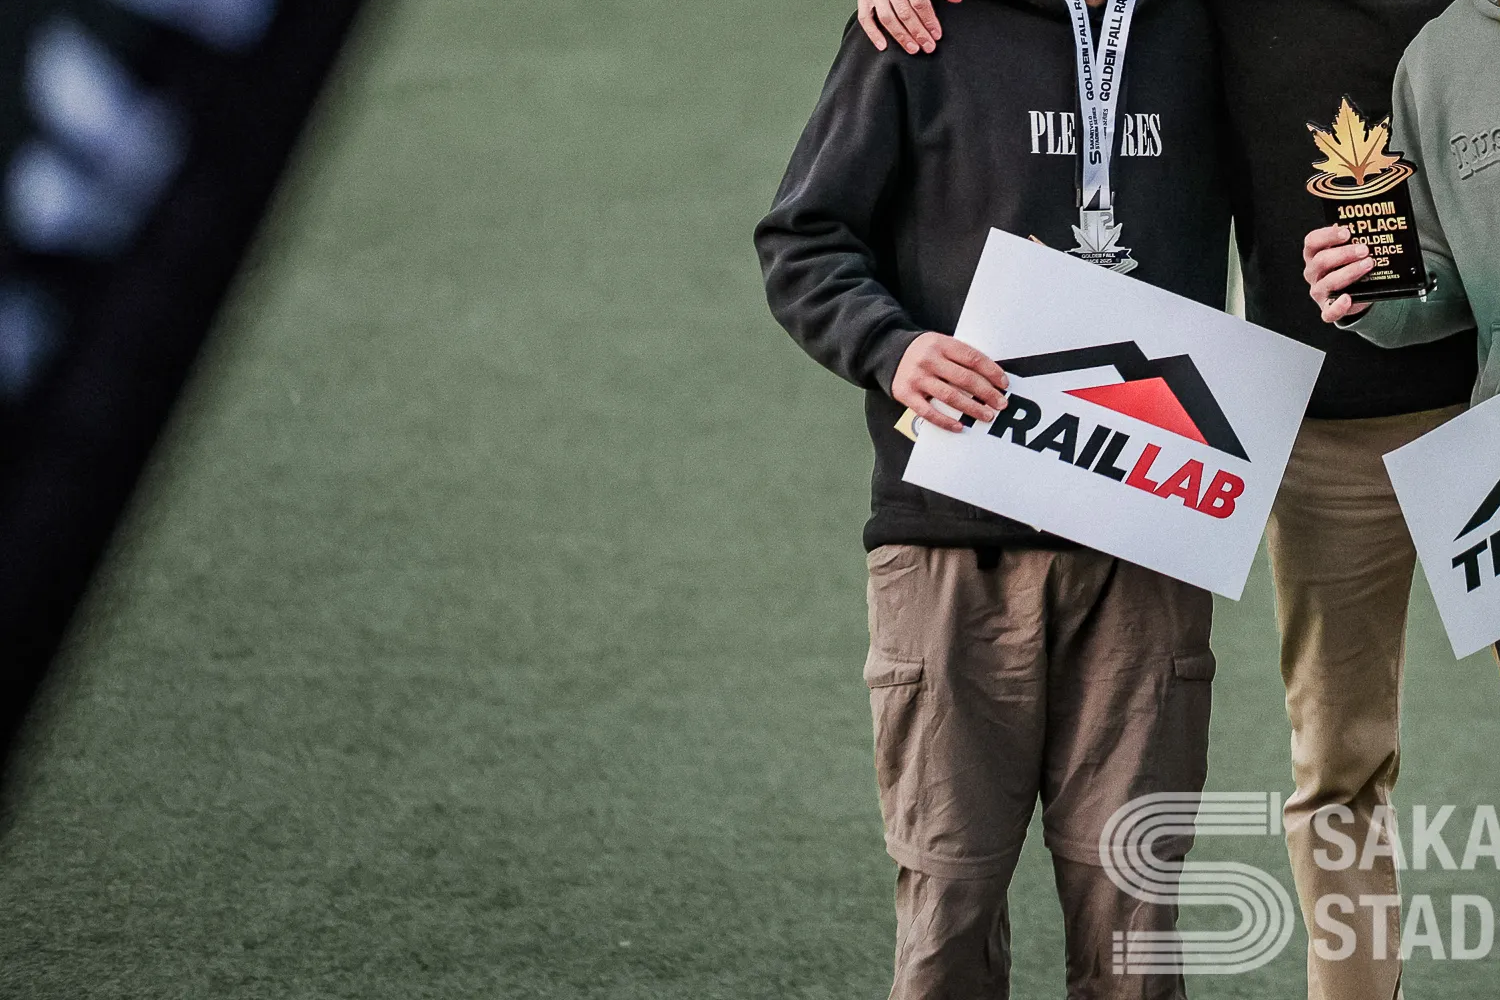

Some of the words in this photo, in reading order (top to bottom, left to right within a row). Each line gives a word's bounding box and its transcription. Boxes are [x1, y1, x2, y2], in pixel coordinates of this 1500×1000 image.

[1077, 13, 1088, 45] FALL
[1107, 16, 1123, 47] FALL
[1081, 48, 1095, 100] GOLDEN
[1100, 48, 1117, 101] GOLDEN
[1028, 110, 1163, 157] PLERES
[1337, 201, 1396, 220] 10000M
[1356, 216, 1408, 234] PLACE
[1351, 233, 1395, 246] GOLDEN
[1374, 244, 1404, 256] RACE
[958, 388, 1245, 519] RAILLAB
